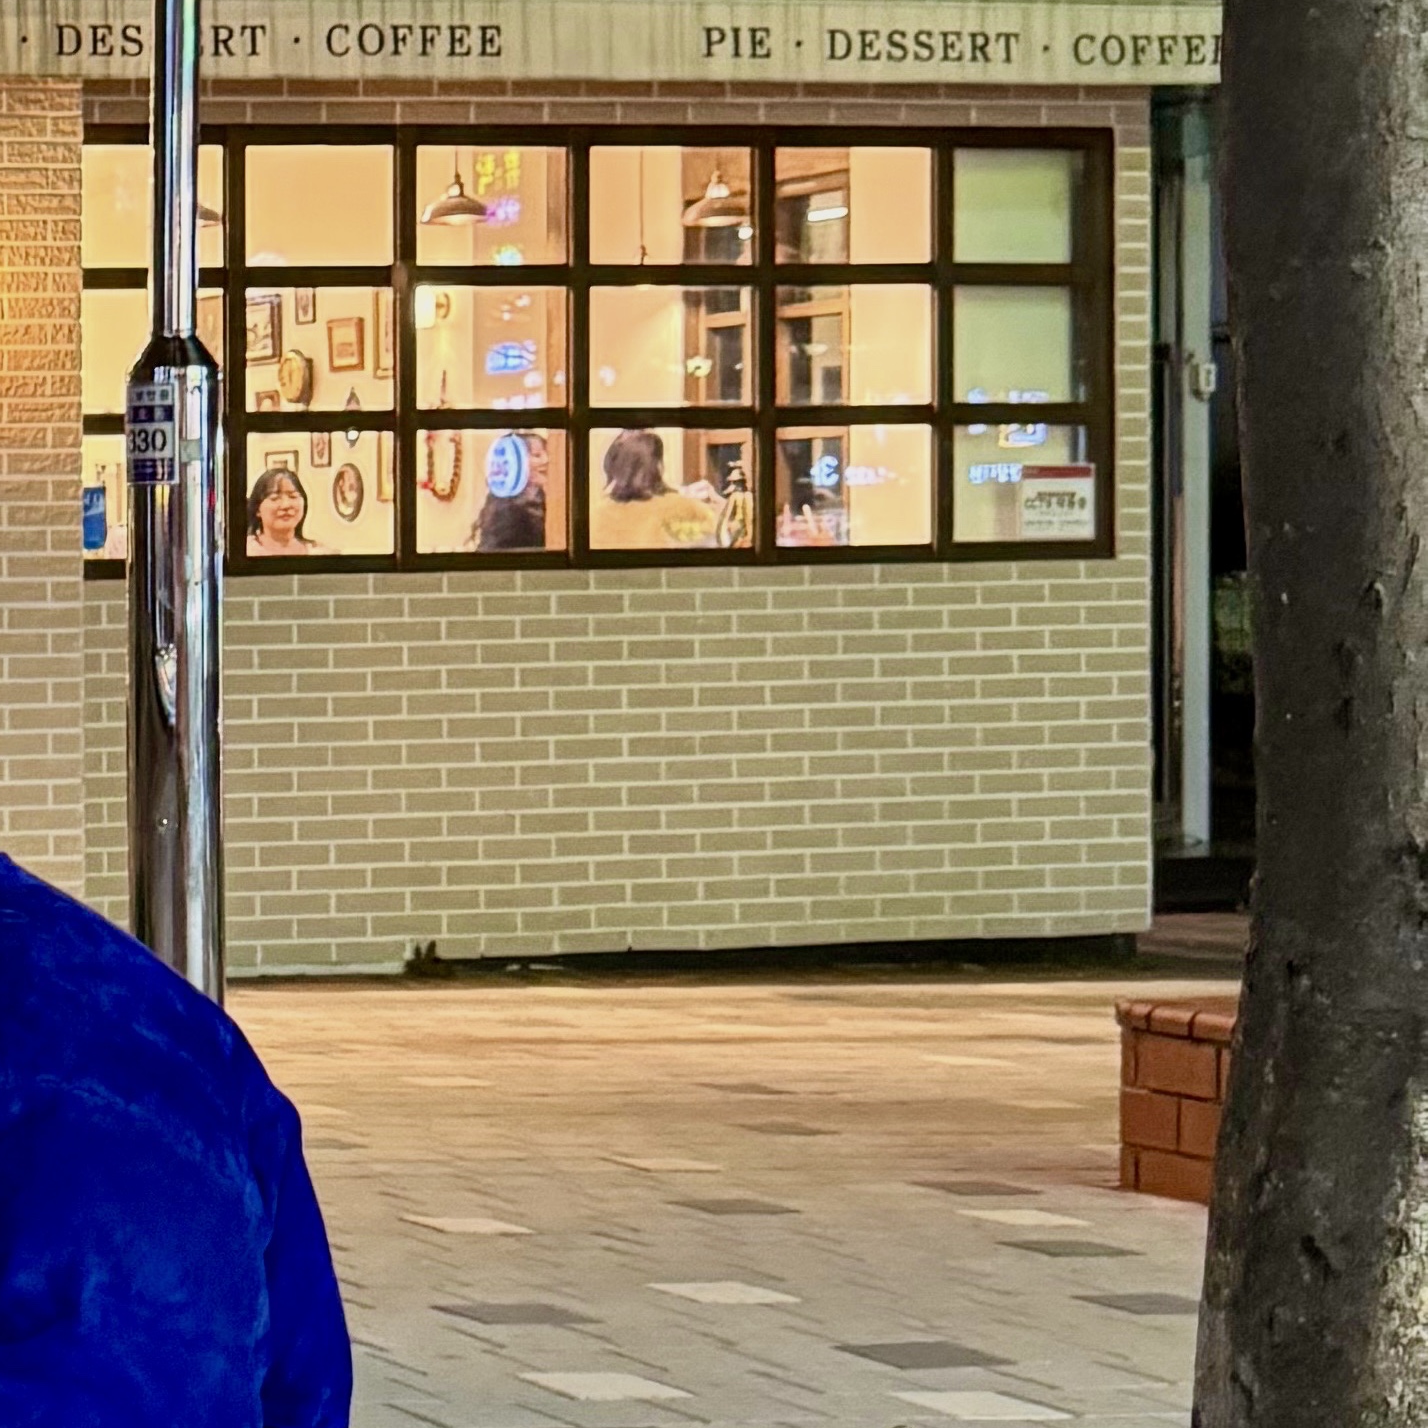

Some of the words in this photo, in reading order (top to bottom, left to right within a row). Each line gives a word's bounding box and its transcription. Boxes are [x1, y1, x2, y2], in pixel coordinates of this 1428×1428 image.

[55, 22, 267, 59] DESRT
[325, 22, 503, 58] COFFEE
[702, 26, 772, 59] PIE
[827, 28, 1022, 64] DESSERT
